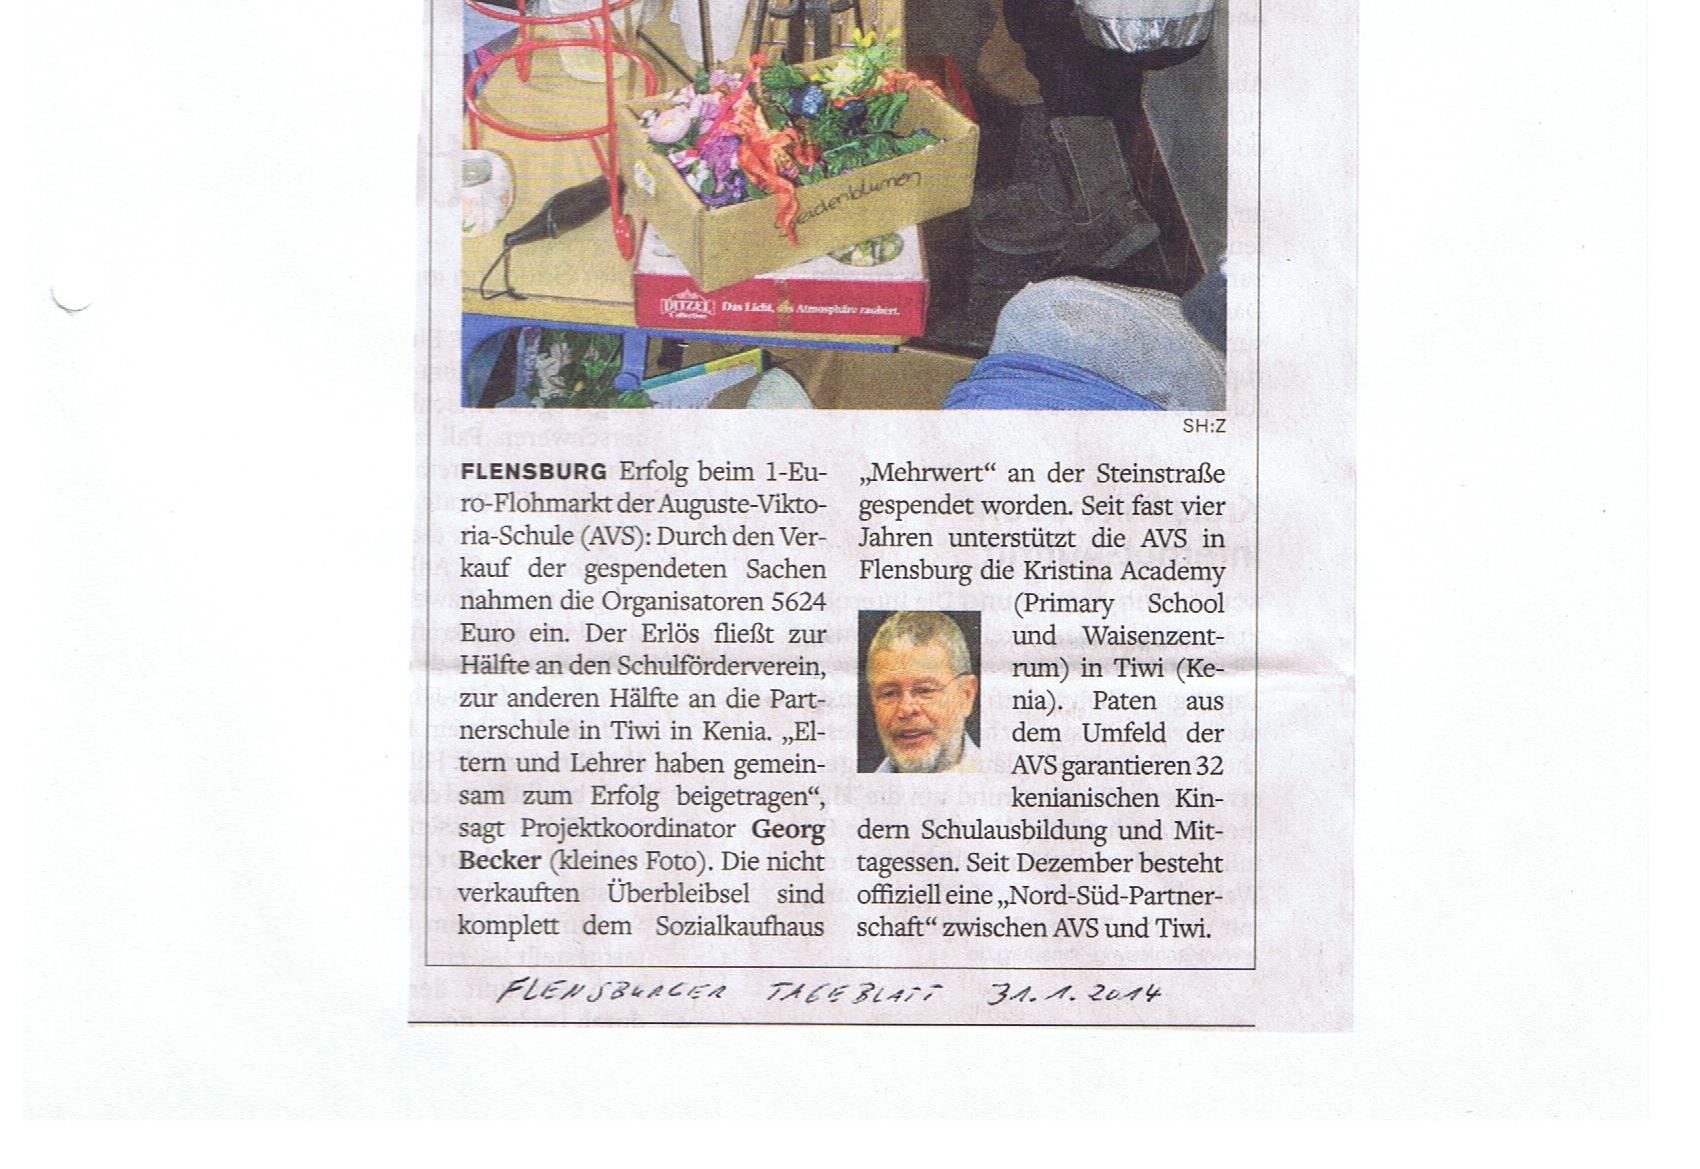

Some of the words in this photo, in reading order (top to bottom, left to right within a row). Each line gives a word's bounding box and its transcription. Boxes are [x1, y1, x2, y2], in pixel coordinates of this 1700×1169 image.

[663, 298, 711, 313] DITZEL
[722, 301, 743, 312] Das
[745, 301, 774, 313] Licht,
[1183, 418, 1227, 434] SH:Z
[461, 462, 607, 481] FLENSBURG
[619, 458, 689, 488] Erfolg
[697, 459, 756, 482] beim
[766, 461, 828, 482] 1-Eu-
[1007, 467, 1035, 483] an
[1047, 461, 1086, 484] der
[1096, 461, 1226, 484] Steinstraße
[460, 491, 614, 514] ro-Flohmarkt
[617, 491, 656, 514] der
[657, 492, 828, 521] Auguste-Vikto-
[858, 492, 975, 522] gespendet
[980, 493, 1073, 516] worden.
[1081, 494, 1125, 516] Seit
[1131, 493, 1174, 516] fast
[1180, 495, 1227, 516] vier
[460, 524, 574, 546] ria-Schule
[581, 525, 651, 552] (AVS):
[656, 524, 728, 546] Durch
[732, 524, 775, 546] den
[778, 526, 827, 547] Ver-
[858, 525, 934, 548] Jahren
[948, 527, 1077, 548] unterstützt
[1091, 526, 1126, 548] die
[1139, 528, 1188, 549] AVS
[1202, 528, 1226, 548] in
[460, 556, 513, 578] kauf
[528, 556, 567, 578] der
[584, 556, 727, 585] gespendeten
[746, 557, 828, 580] Sachen
[859, 558, 973, 587] Flensburg
[980, 558, 1015, 580] die
[1023, 559, 1113, 581] Kristina
[1120, 558, 1227, 588] Academy
[460, 588, 553, 610] nahmen
[560, 588, 594, 611] die
[602, 590, 765, 618] Organisatoren
[771, 591, 827, 612] 5624
[1014, 592, 1116, 620] (Primary
[1148, 591, 1225, 614] School
[460, 622, 516, 643] Euro
[529, 622, 570, 643] ein.
[585, 622, 628, 643] Der
[641, 622, 700, 644] Erlös
[713, 622, 775, 644] fließt
[788, 629, 828, 644] zur
[1011, 623, 1058, 646] und
[1081, 624, 1225, 646] Waisenzent-
[460, 652, 531, 675] Hälfte
[535, 660, 564, 675] an
[569, 653, 612, 676] den
[617, 653, 826, 680] Schulförderverein,
[1011, 656, 1070, 684] rum)
[1080, 656, 1104, 678] in
[1113, 656, 1165, 678] Tiwi
[1176, 657, 1225, 684] (Ke-
[459, 692, 498, 708] zur
[507, 686, 600, 708] anderen
[609, 686, 679, 708] Hälfte
[688, 693, 717, 708] an
[725, 686, 761, 709] die
[770, 688, 826, 710] Part-
[1012, 689, 1063, 717] nia).
[1092, 690, 1158, 711] Paten
[1186, 695, 1224, 711] aus
[459, 718, 570, 740] nerschule
[579, 719, 602, 740] in
[610, 719, 661, 740] Tiwi
[670, 720, 693, 740] in
[702, 720, 772, 742] Kenia.
[1011, 720, 1062, 743] dem
[1081, 720, 1167, 744] Umfeld
[1186, 721, 1225, 744] der
[458, 755, 507, 772] tern
[515, 750, 561, 773] und
[570, 750, 647, 773] Lehrer
[655, 751, 725, 774] haben
[733, 752, 826, 780] gemein-
[1010, 754, 1058, 776] AVS
[1061, 754, 1192, 782] garantieren
[1196, 755, 1224, 776] 32
[459, 789, 505, 805] sam
[523, 790, 574, 806] zum
[590, 783, 661, 812] Erfolg
[1011, 786, 1161, 808] kenianischen
[1175, 787, 1225, 808] Kin-
[459, 821, 505, 844] sagt
[520, 816, 737, 845] Projektkoordinator
[751, 818, 826, 846] Georg
[857, 817, 911, 840] dern
[921, 818, 1109, 848] Schulausbildung
[1117, 818, 1164, 841] und
[1173, 819, 1224, 841] Mit-
[458, 848, 542, 870] Becker
[550, 848, 638, 877] (kleines
[645, 850, 713, 878] Foto).
[721, 850, 760, 872] Die
[766, 849, 825, 872] nicht
[856, 852, 960, 880] tagessen.
[966, 851, 1010, 873] Seit
[1016, 851, 1134, 874] Dezember
[1138, 851, 1224, 874] besteht
[457, 881, 580, 903] verkauften
[607, 877, 750, 904] Überbleibsel
[777, 882, 825, 905] sind
[857, 882, 942, 905] offiziell
[945, 884, 993, 905] eine
[457, 913, 560, 942] komplett
[582, 913, 633, 936] dem
[656, 914, 825, 937] Sozialkaufhaus
[942, 915, 1048, 938] zwischen
[1052, 917, 1099, 939] AVS
[1104, 916, 1150, 939] und
[1155, 917, 1212, 939] Tiwi.
[496, 975, 728, 1004] FLENSBURGER
[766, 981, 944, 1005] TAGEBLATT
